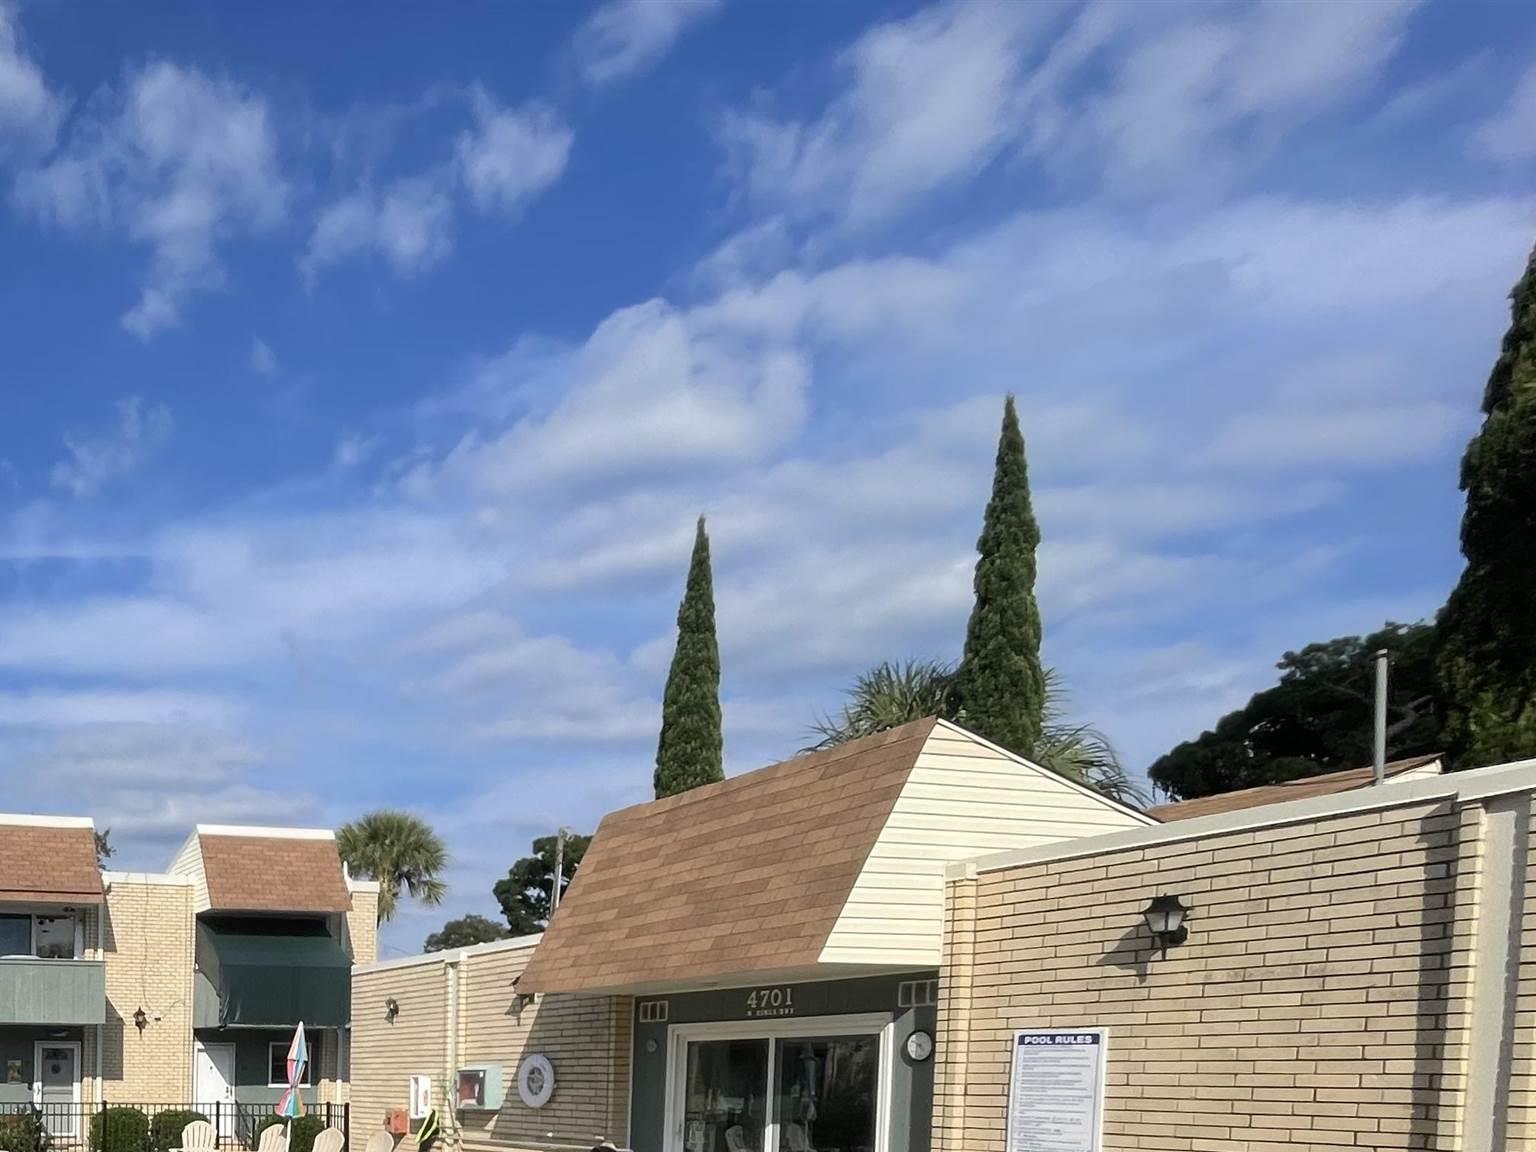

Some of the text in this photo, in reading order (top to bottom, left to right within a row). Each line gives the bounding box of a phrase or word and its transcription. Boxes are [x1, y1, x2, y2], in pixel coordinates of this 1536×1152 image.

[747, 988, 793, 1008] 4701
[1024, 1035, 1093, 1045] POOL RULES
